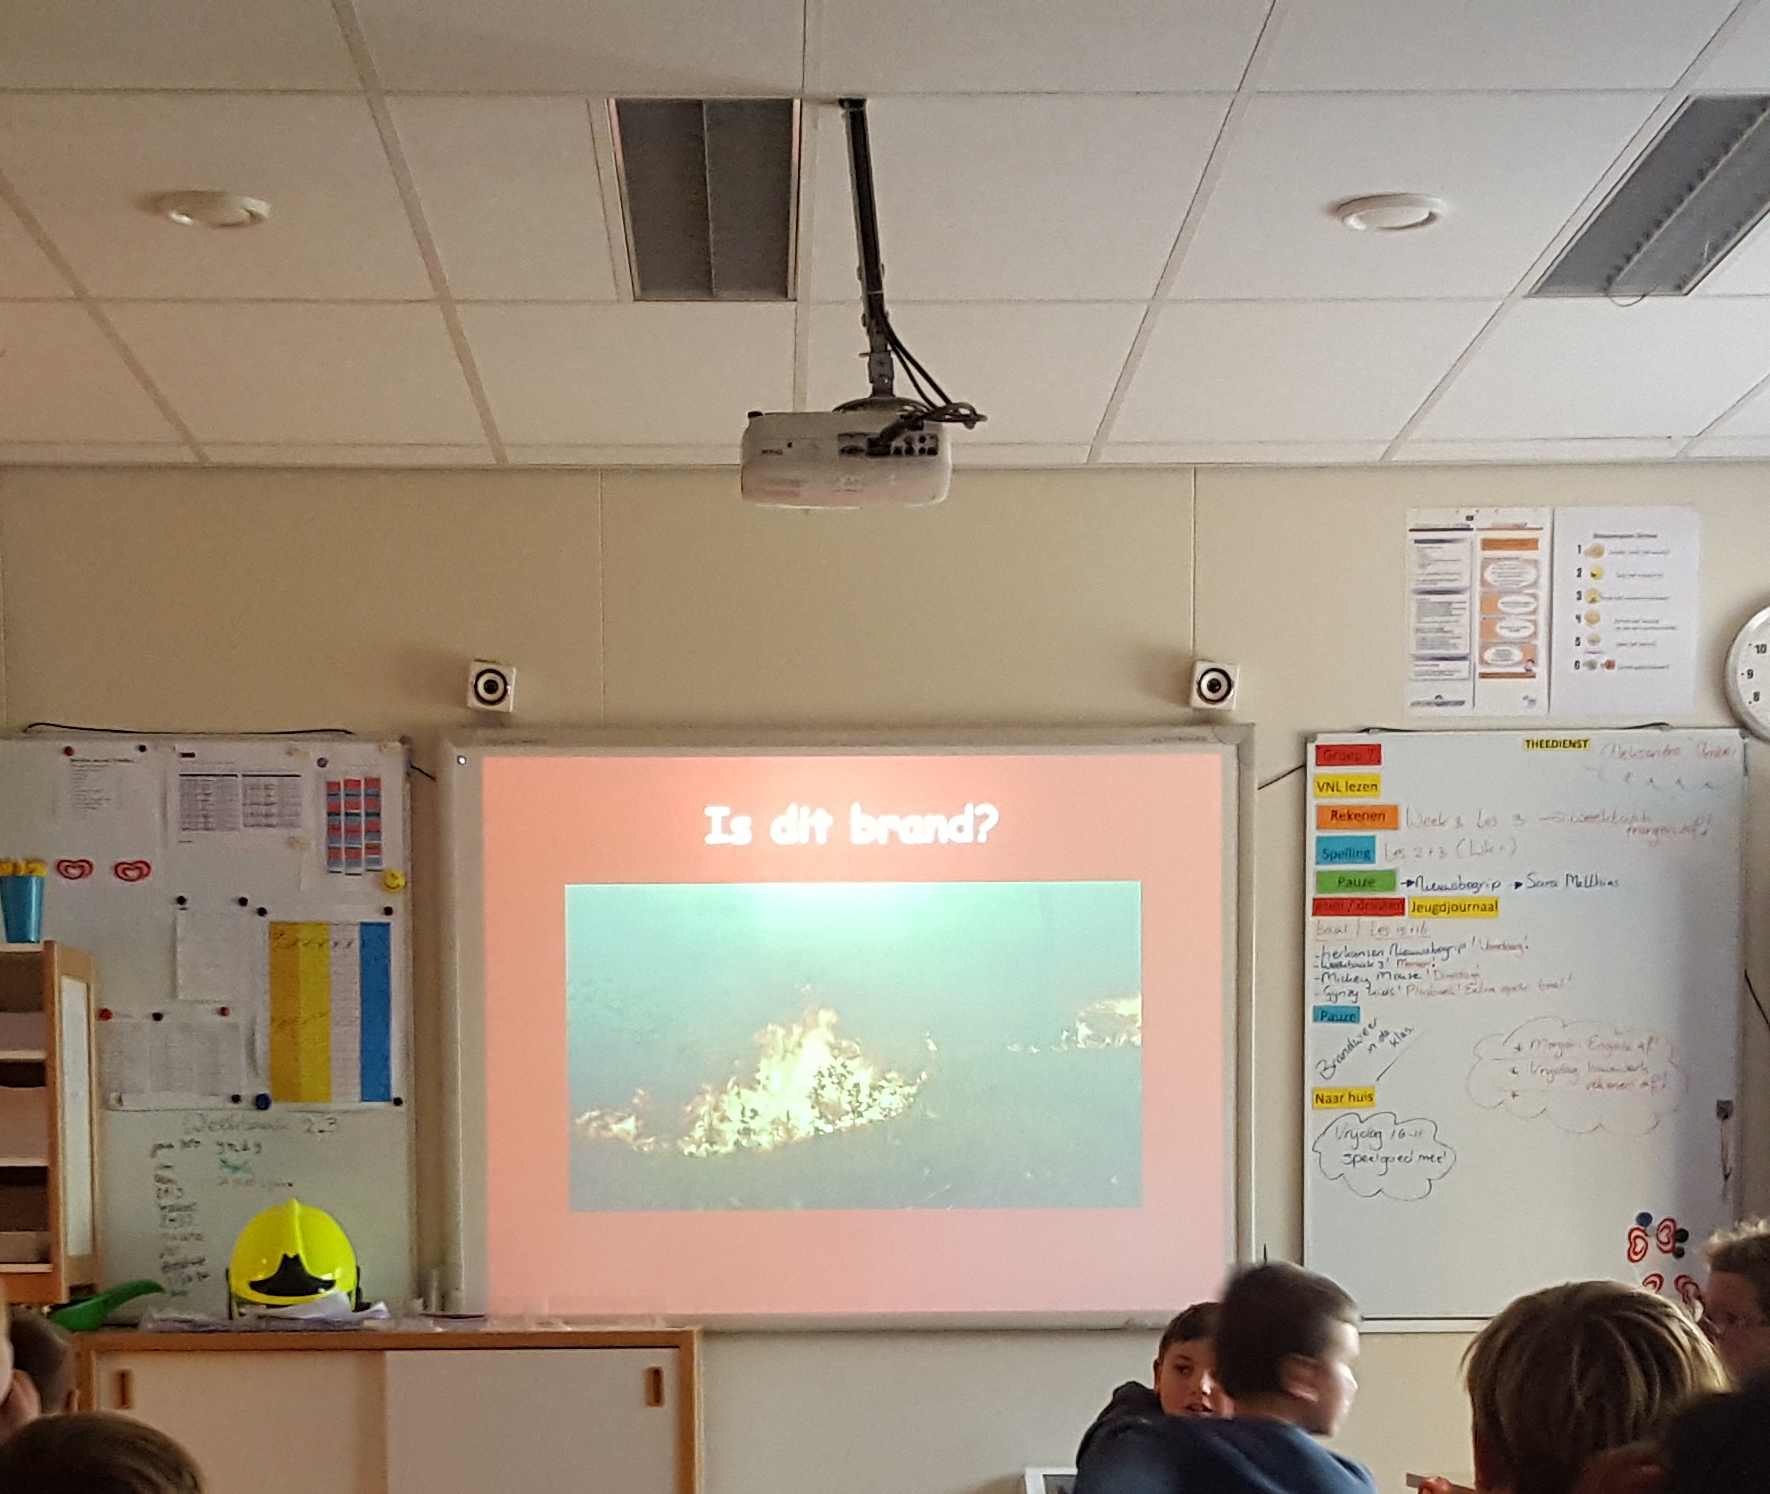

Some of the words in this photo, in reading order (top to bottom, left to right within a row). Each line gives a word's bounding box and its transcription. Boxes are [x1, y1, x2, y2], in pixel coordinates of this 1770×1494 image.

[1754, 643, 1767, 654] 10
[1746, 668, 1754, 679] 9
[1753, 691, 1760, 702] 8
[1525, 739, 1590, 750] THEEDIENST
[1316, 780, 1343, 793] VNL
[1345, 780, 1378, 793] lezen
[1330, 808, 1386, 823] Rekenen
[703, 805, 753, 845] Is
[770, 802, 833, 845] dit
[850, 802, 1000, 845] brand?
[1321, 847, 1371, 862] Spelling
[1337, 875, 1376, 888] Pauze
[1411, 899, 1498, 916] Jeugdjournaal
[1320, 1010, 1356, 1022] Pauze
[1315, 1092, 1345, 1104] Naar
[1348, 1090, 1374, 1103] huis
